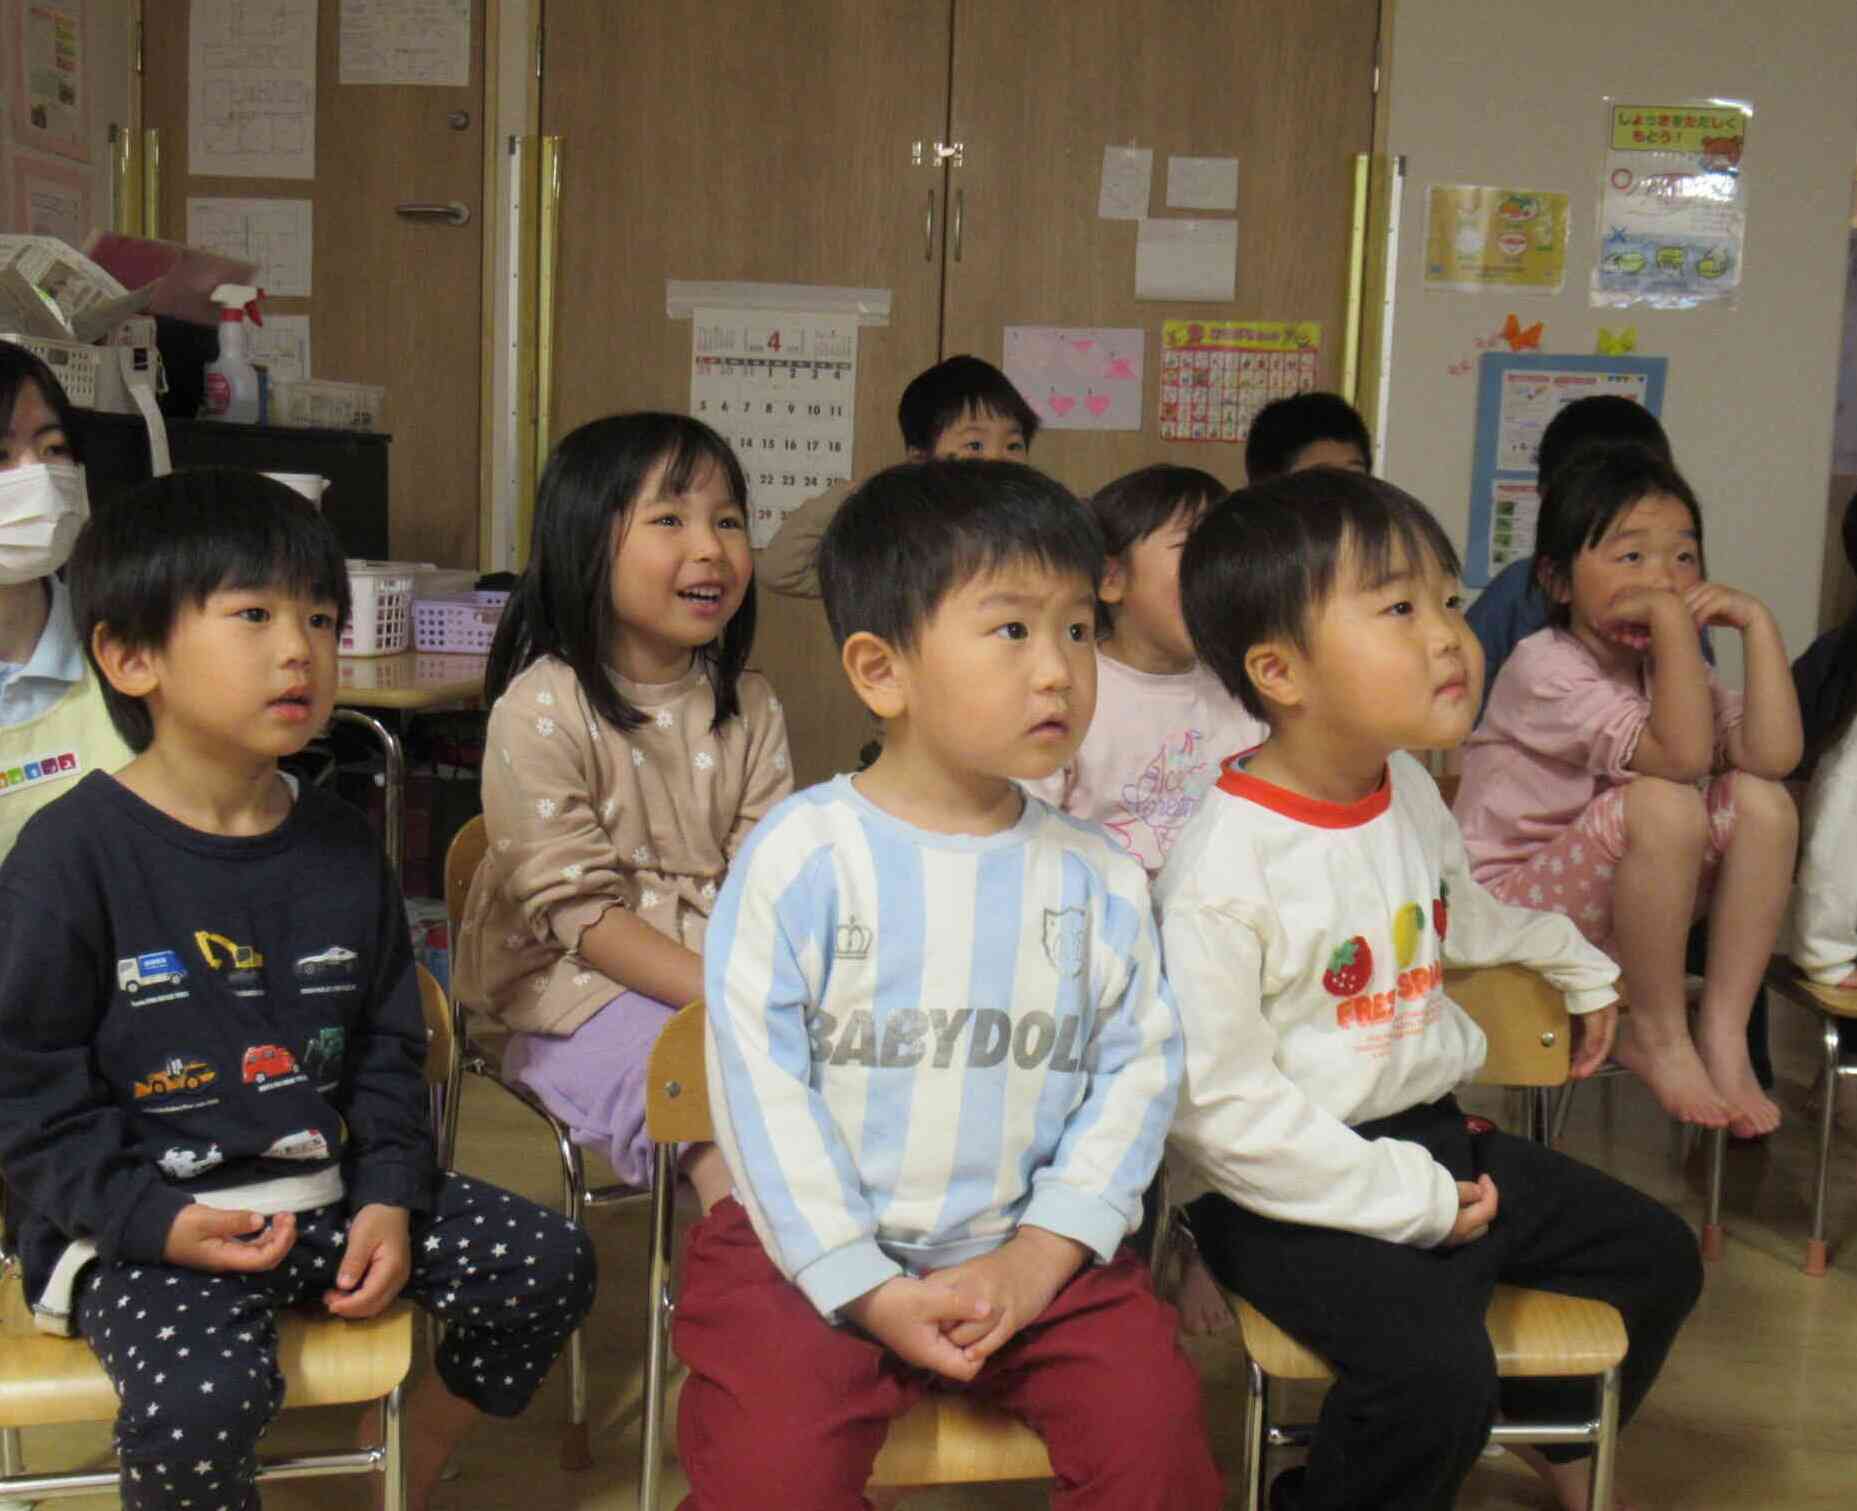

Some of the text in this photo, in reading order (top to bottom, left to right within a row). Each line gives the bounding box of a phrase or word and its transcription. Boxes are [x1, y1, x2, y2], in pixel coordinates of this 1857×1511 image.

[767, 329, 781, 352] 4
[700, 401, 842, 416] 5 6 7 8 9 10 11
[740, 437, 842, 452] 14 15 16 17 18
[760, 474, 774, 485] 22
[782, 475, 795, 486] 23
[804, 476, 817, 487] 24
